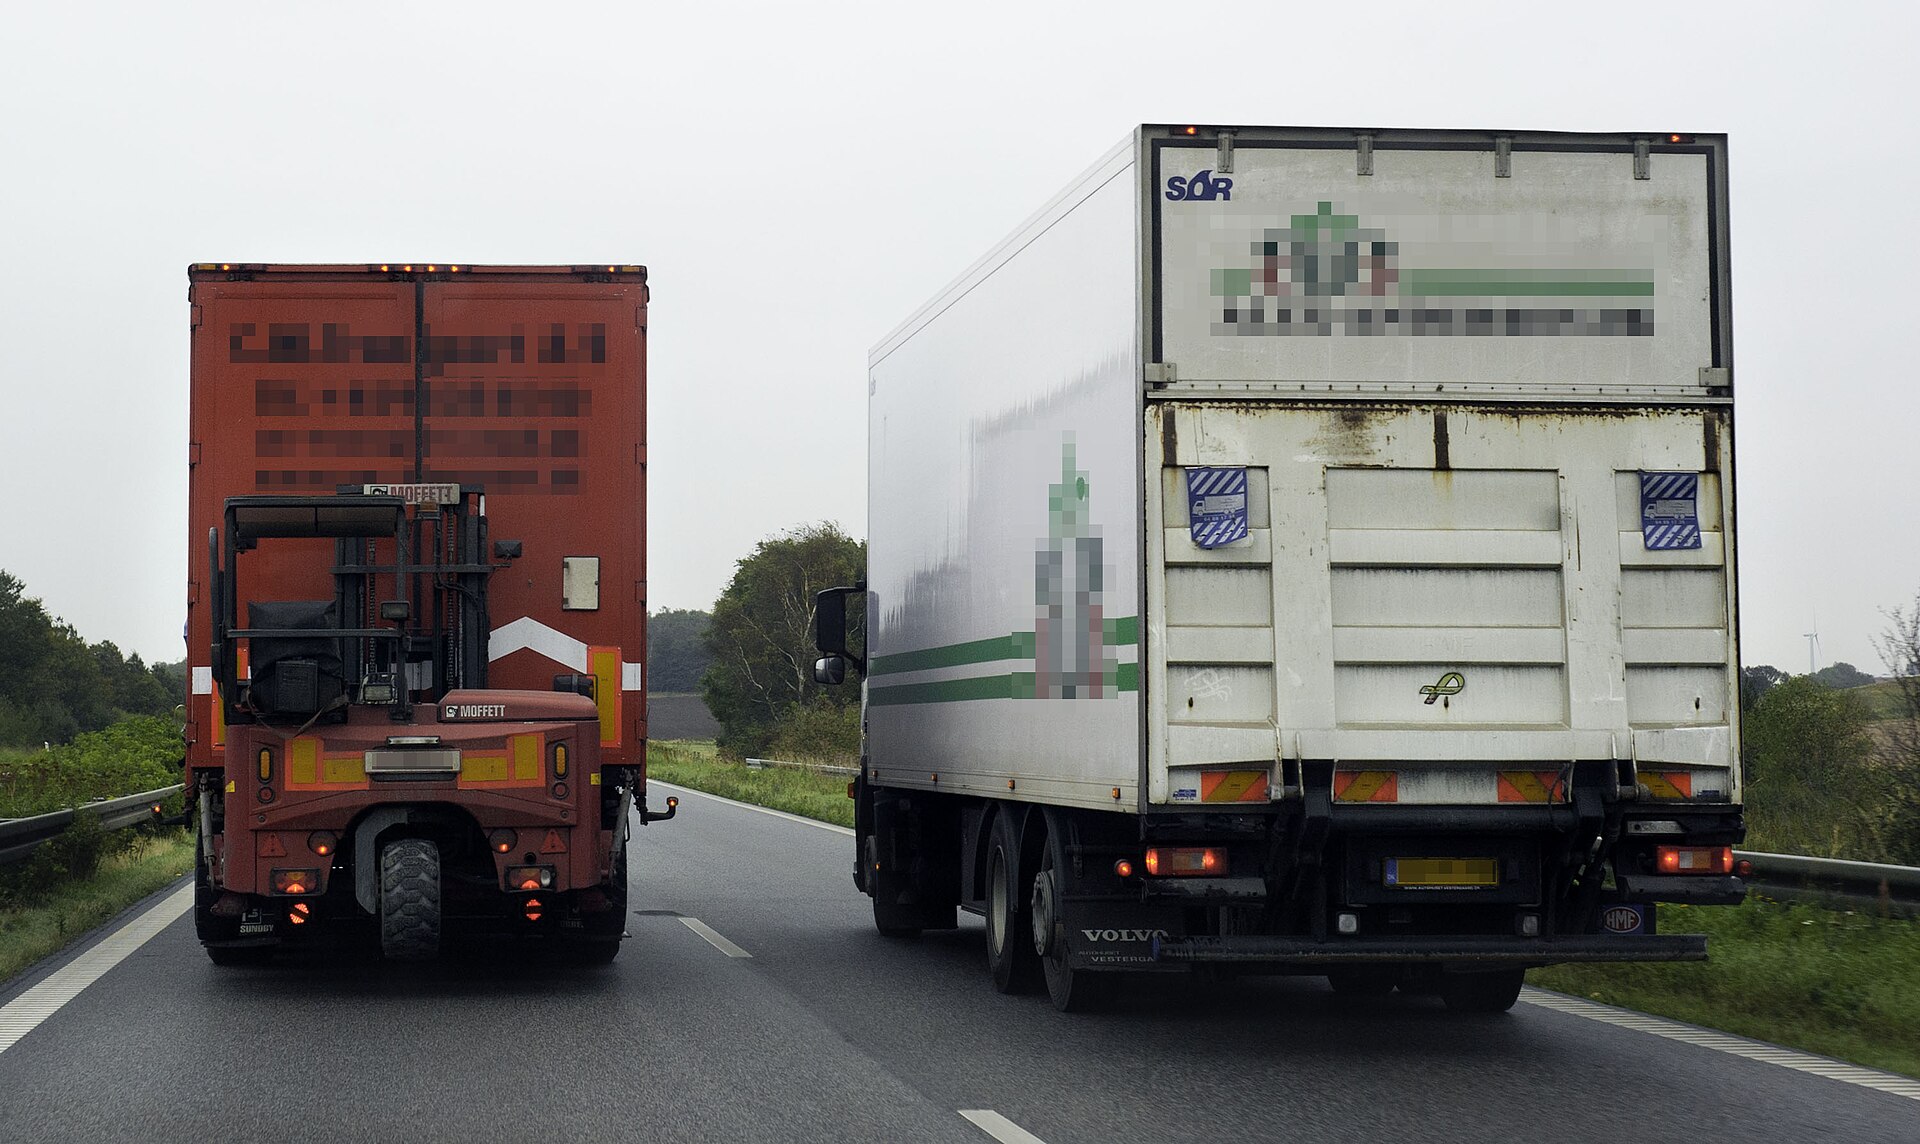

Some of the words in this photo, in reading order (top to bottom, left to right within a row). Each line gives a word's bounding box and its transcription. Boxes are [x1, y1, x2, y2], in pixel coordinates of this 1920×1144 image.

[1165, 169, 1233, 201] SOR
[390, 486, 453, 503] MOFFETT
[460, 705, 506, 717] MOFFETT
[1606, 910, 1635, 929] HMF
[239, 924, 274, 933] SUNDBY
